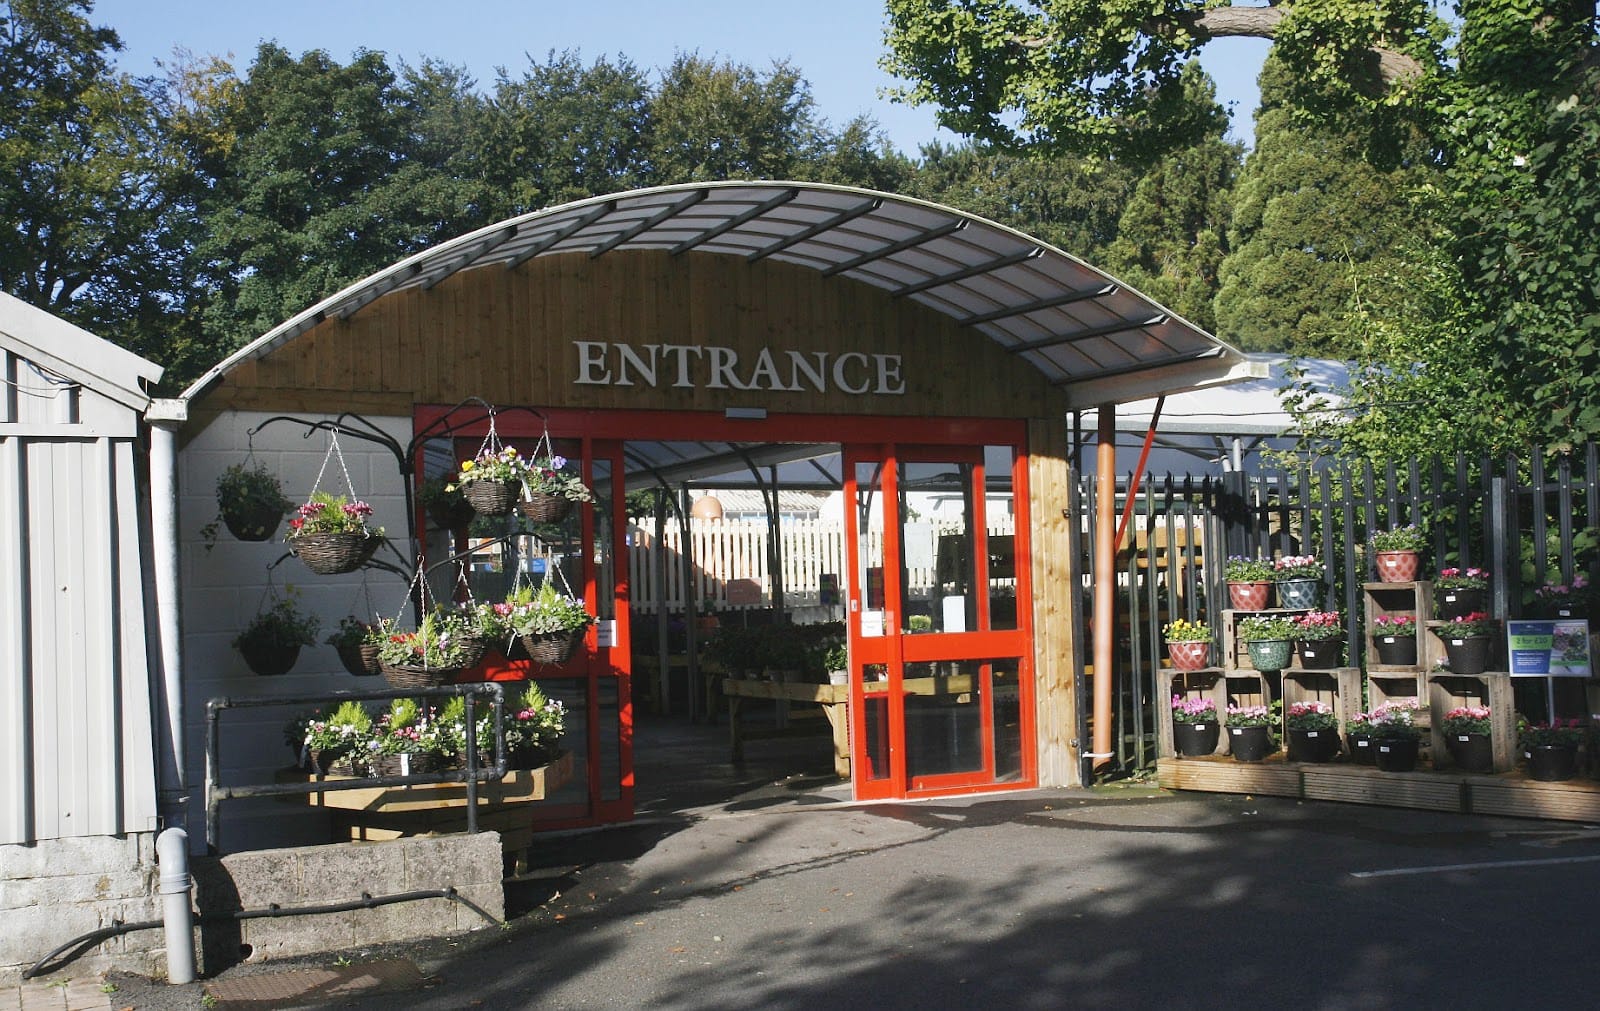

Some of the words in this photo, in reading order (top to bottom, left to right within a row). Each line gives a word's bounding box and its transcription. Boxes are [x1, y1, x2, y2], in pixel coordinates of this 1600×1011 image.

[572, 340, 906, 395] ENTRANCE
[1516, 636, 1521, 644] 2
[1522, 636, 1533, 644] for
